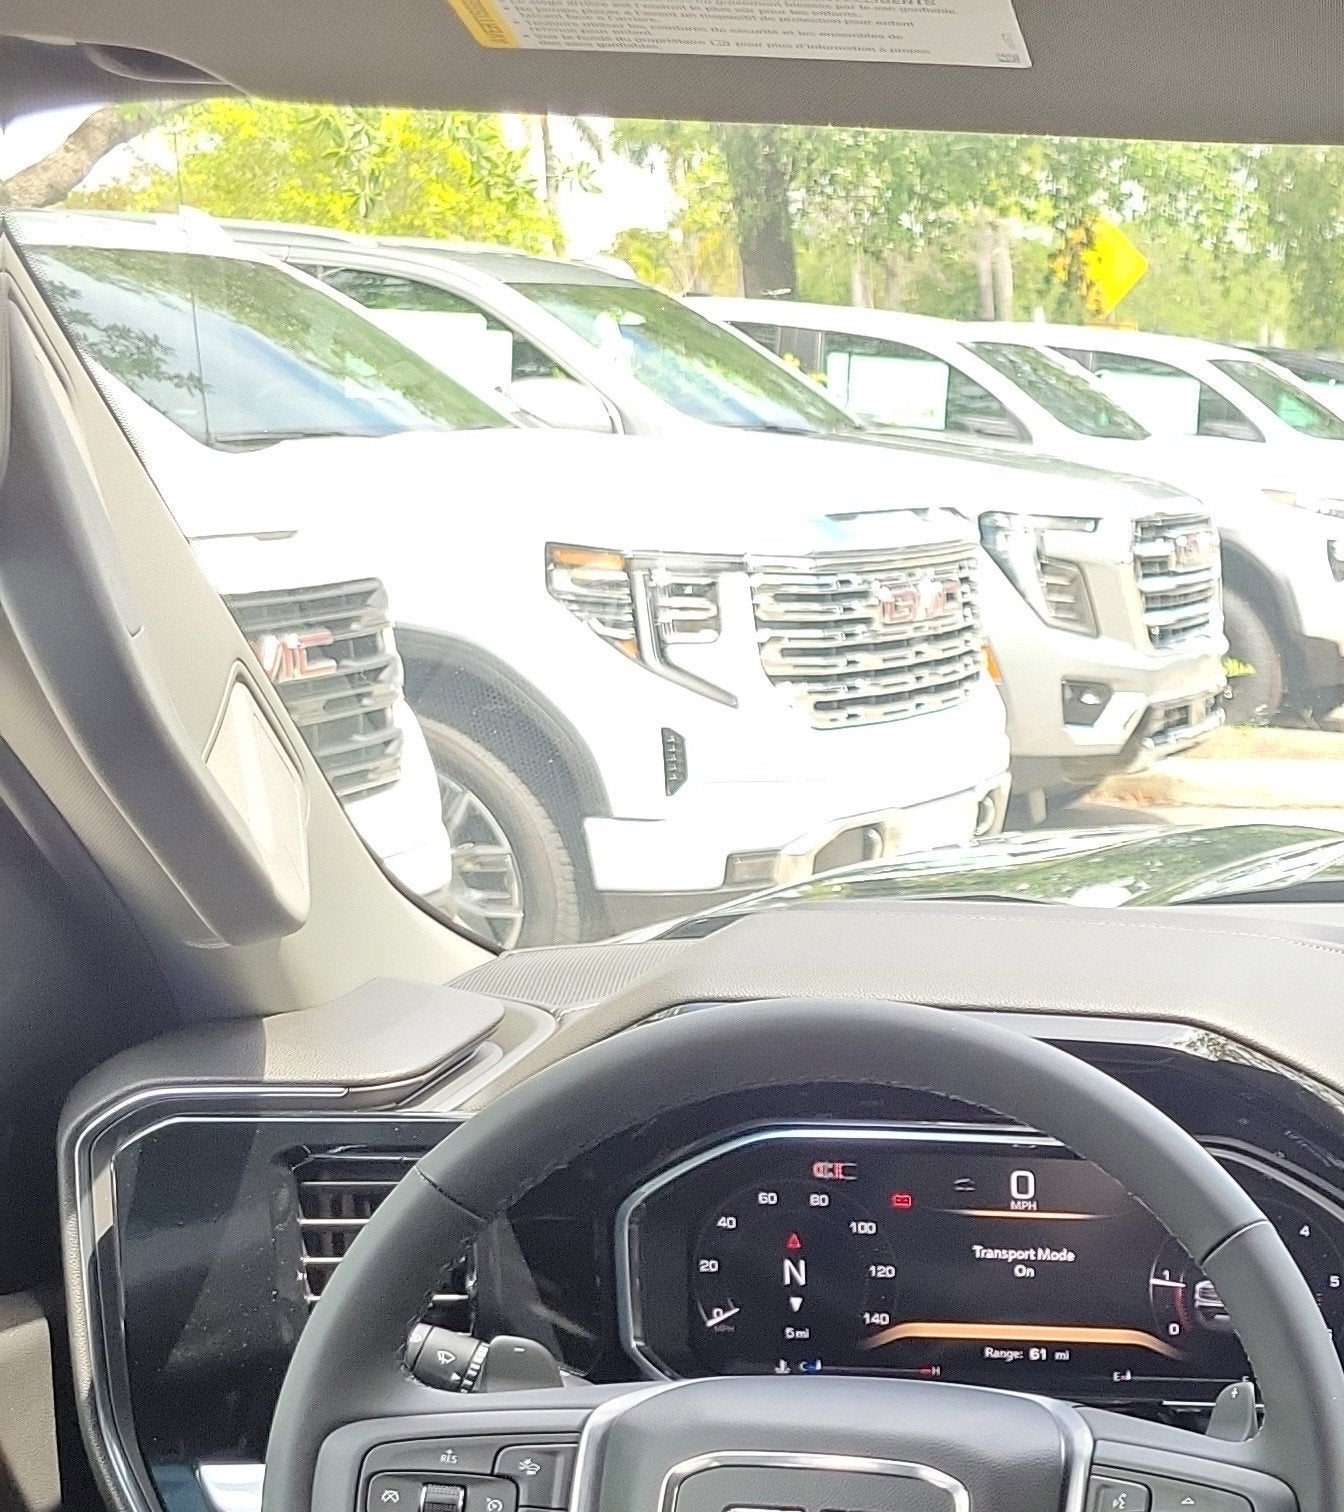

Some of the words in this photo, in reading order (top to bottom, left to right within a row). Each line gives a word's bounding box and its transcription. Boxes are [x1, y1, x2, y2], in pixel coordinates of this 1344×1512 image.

[250, 626, 338, 683] MC
[1009, 1170, 1036, 1200] 0
[757, 1192, 778, 1205] 60
[1009, 1200, 1038, 1211] MPH
[716, 1216, 737, 1229] 40
[848, 1221, 877, 1235] 100
[1299, 1225, 1311, 1237] 4
[971, 1245, 1036, 1263] Transport
[1036, 1248, 1076, 1262] Mode
[699, 1259, 719, 1273] 20
[783, 1258, 807, 1286] N
[868, 1265, 897, 1279] 120
[1013, 1263, 1036, 1278] On
[1329, 1275, 1341, 1288] 5
[862, 1311, 891, 1325] 140
[983, 1347, 1024, 1362] Range:
[1028, 1347, 1047, 1361] 61
[1054, 1348, 1070, 1361] mi
